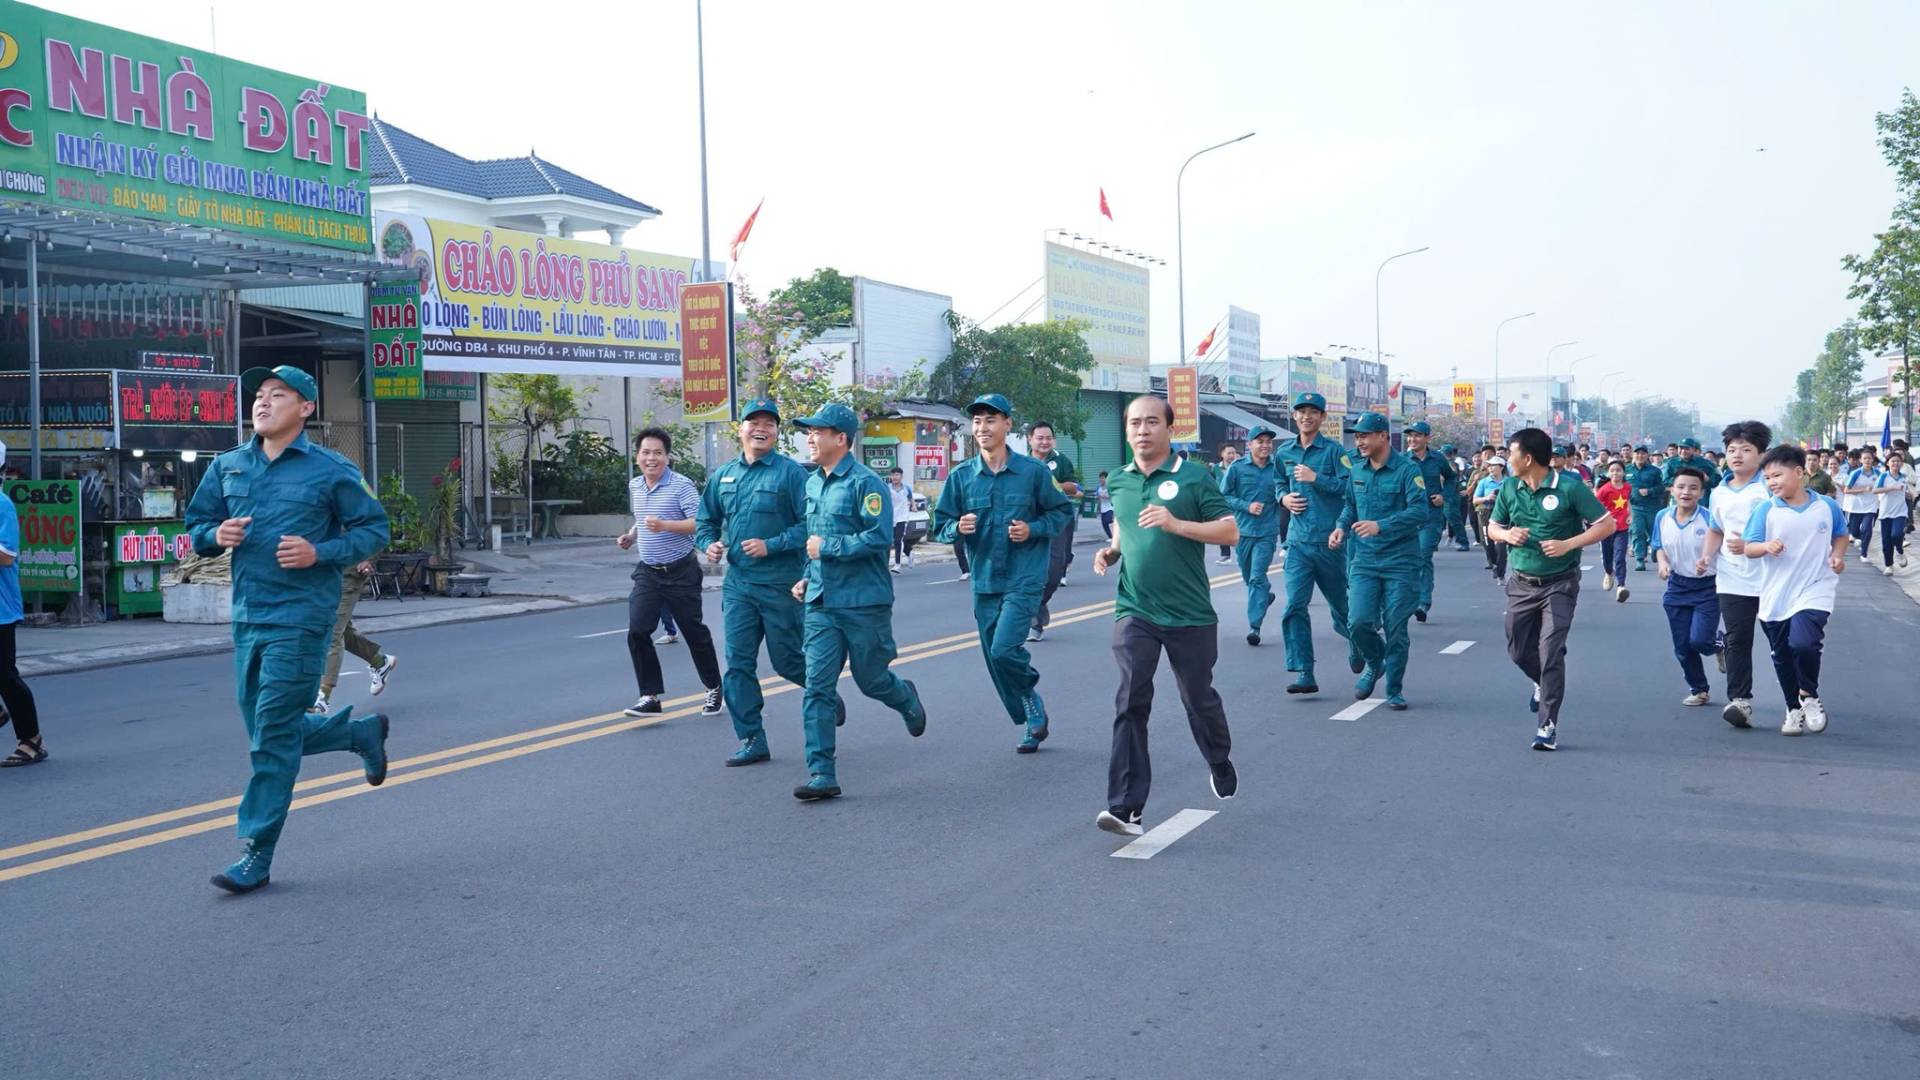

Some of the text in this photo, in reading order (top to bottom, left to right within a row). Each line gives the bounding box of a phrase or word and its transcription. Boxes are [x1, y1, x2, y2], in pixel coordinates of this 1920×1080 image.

[46, 37, 215, 141] NHÀ
[238, 84, 370, 172] ĐẤT
[56, 131, 126, 178] NHẬN
[164, 145, 201, 188] GỬI
[203, 160, 249, 196] MUA
[251, 166, 291, 203] BÁN
[293, 175, 333, 211] NHÀ
[334, 179, 367, 217] ĐẤT
[221, 203, 243, 226] NHÀ
[245, 204, 265, 229] ĐẤT
[442, 230, 517, 297] CHÁO
[519, 238, 586, 304] LÒNG
[371, 297, 417, 329] NHÀ
[435, 297, 470, 329] LÒNG
[481, 301, 508, 331] BÚN
[511, 303, 543, 333] LÒNG
[576, 309, 605, 337] LÒNG
[613, 314, 640, 340] CHÁO
[372, 333, 419, 368] ĐẤT
[465, 342, 488, 353] DB4
[497, 343, 521, 354] KHU
[523, 342, 546, 356] PHỐ
[547, 347, 554, 356] 4
[562, 347, 570, 357] P.
[573, 346, 596, 358] VĨNH
[598, 346, 616, 359] TÂN
[623, 350, 637, 360] TP.
[638, 351, 657, 361] HCM
[664, 353, 678, 362] ĐT:
[1453, 384, 1474, 398] NHÀ
[48, 401, 74, 422] NHÀ
[78, 401, 109, 422] NUÔI
[11, 483, 73, 504] Café
[121, 530, 141, 562] RÚT
